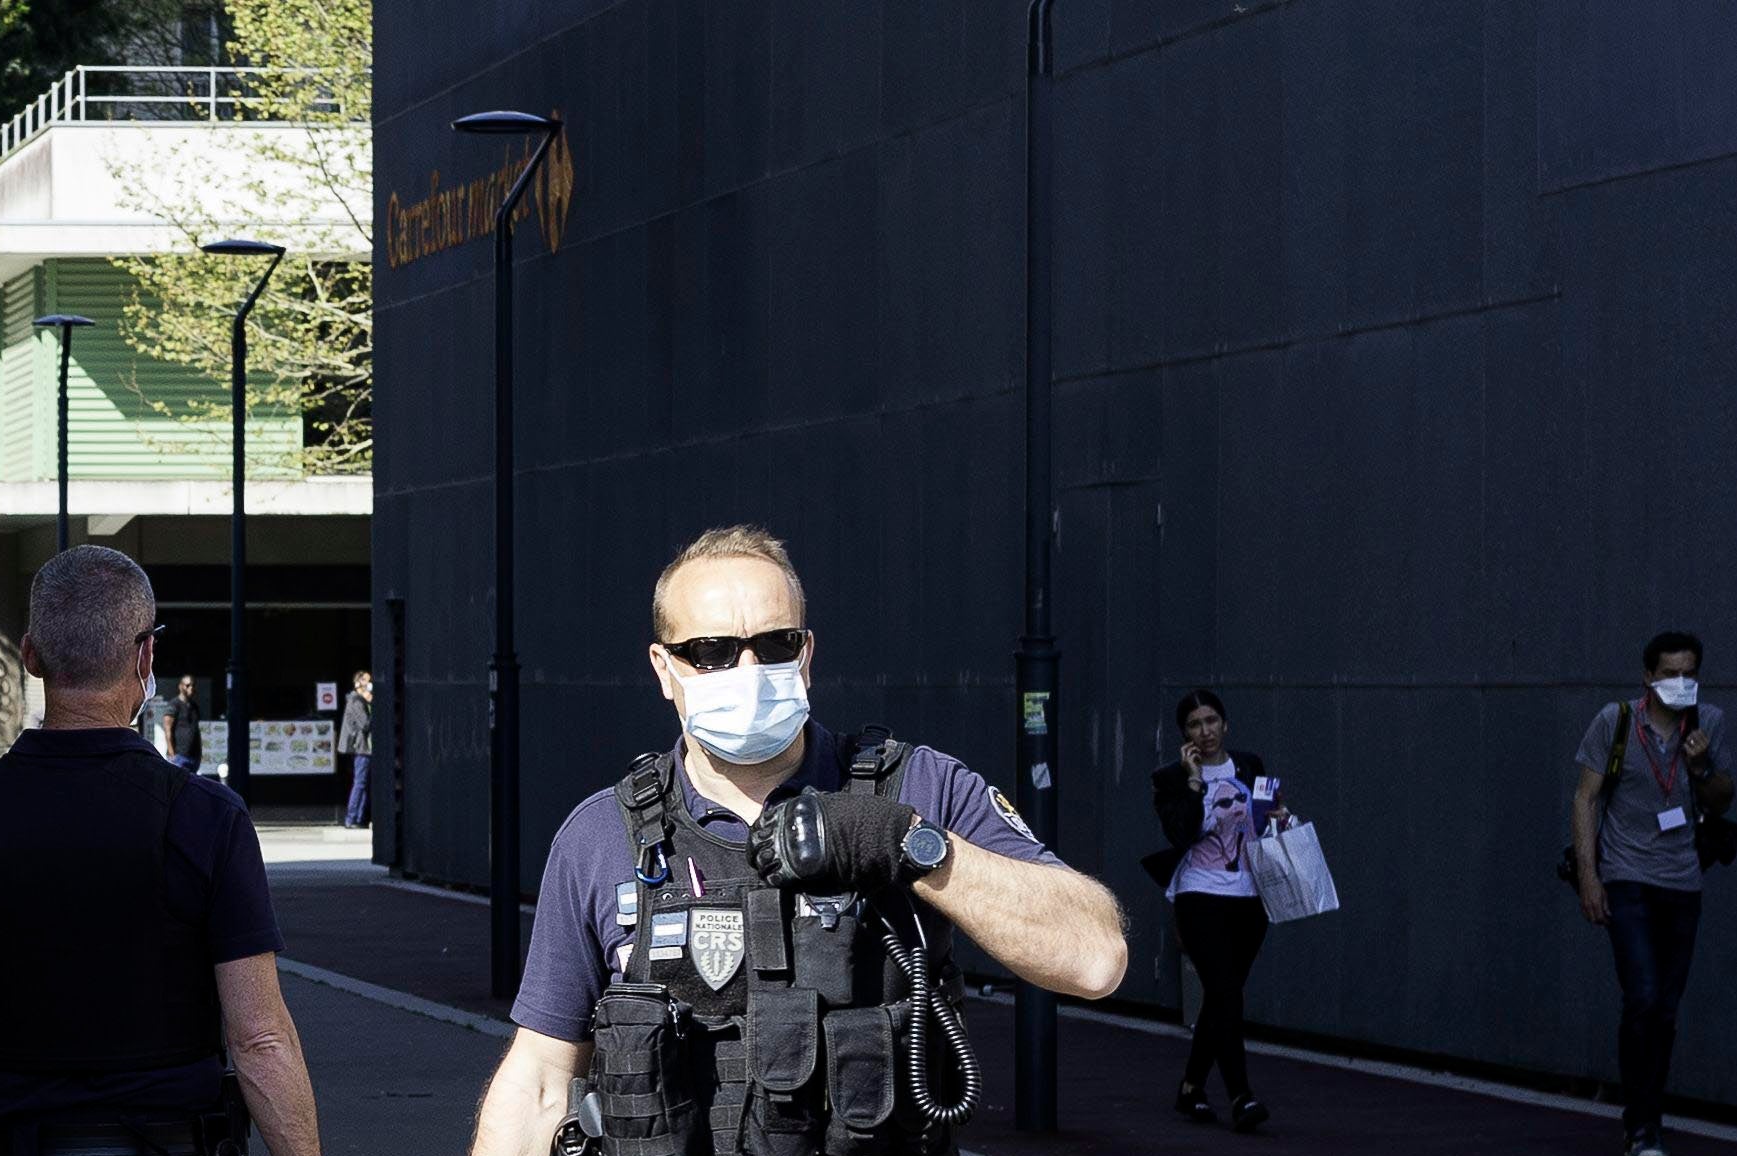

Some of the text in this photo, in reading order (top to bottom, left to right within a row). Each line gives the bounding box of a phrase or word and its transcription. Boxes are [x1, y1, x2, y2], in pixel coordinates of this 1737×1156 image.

[387, 169, 465, 270] Carrefour
[700, 914, 739, 923] POLICE
[695, 923, 743, 931] NATIONALE
[693, 931, 743, 952] CRS
